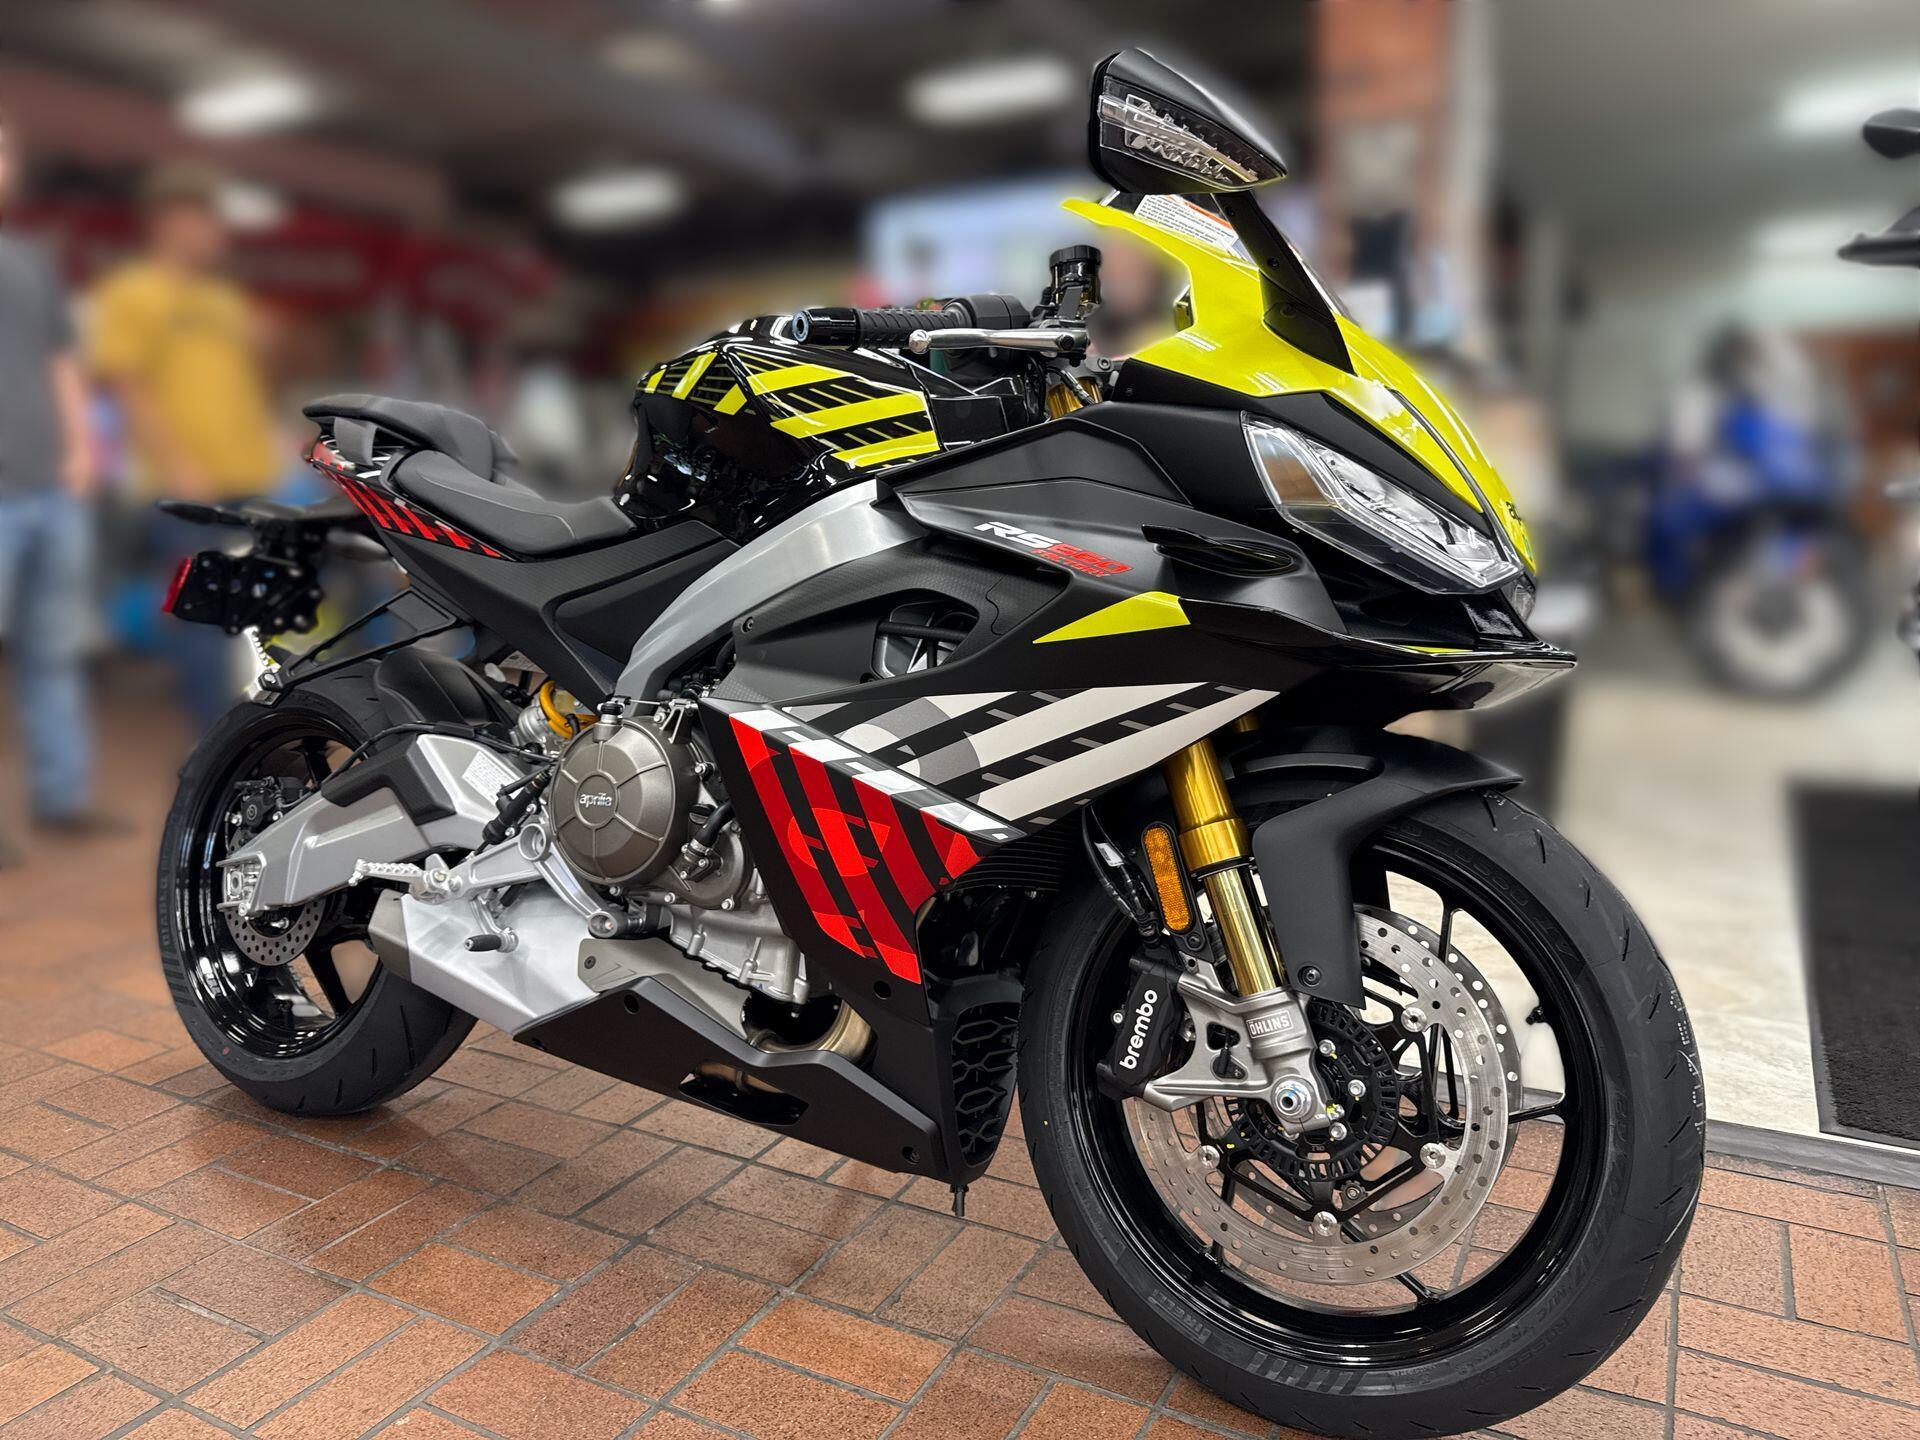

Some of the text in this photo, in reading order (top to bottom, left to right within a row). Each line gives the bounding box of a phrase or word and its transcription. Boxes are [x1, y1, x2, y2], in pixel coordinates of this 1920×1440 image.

[1030, 548, 1112, 578] FACTORY
[579, 791, 613, 808] aprilia
[1119, 989, 1158, 1070] brembo
[1147, 1288, 1213, 1345] PIRELLI
